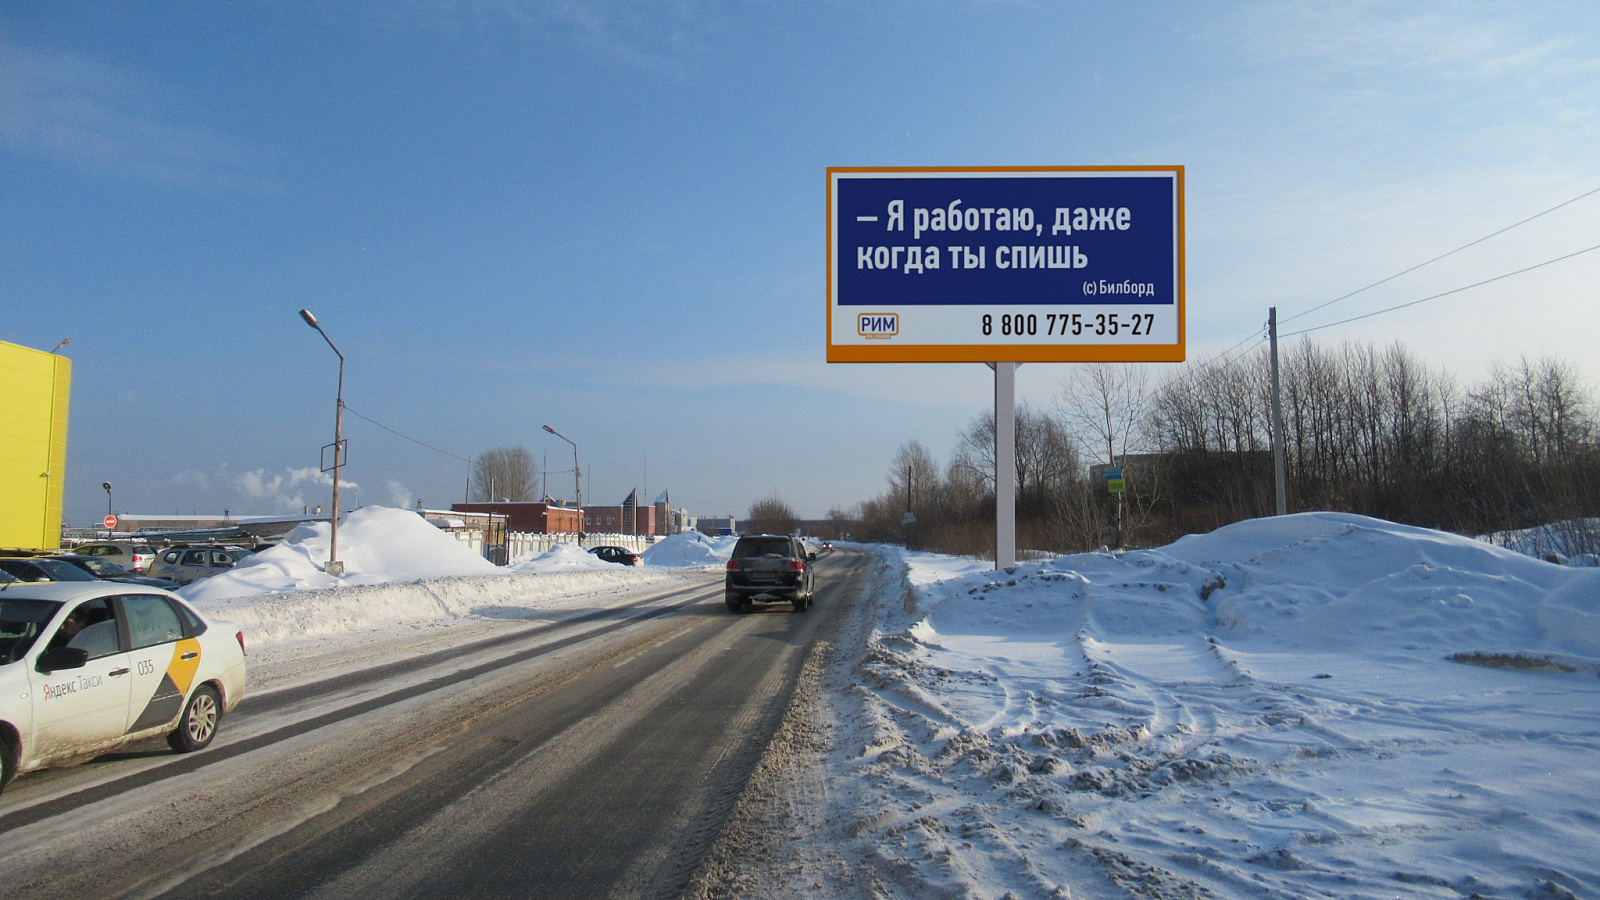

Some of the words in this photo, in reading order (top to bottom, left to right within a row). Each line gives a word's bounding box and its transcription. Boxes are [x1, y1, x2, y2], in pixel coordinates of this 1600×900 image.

[886, 200, 903, 231] Я
[914, 199, 1042, 239] работаю,
[1052, 207, 1131, 235] даже
[858, 246, 940, 274] когда
[948, 246, 986, 269] ты
[996, 246, 1088, 269] спишь
[1100, 280, 1155, 298] Билборд
[861, 317, 895, 332] РИМ
[982, 314, 993, 335] 8
[1002, 314, 1037, 335] 800
[1047, 314, 1155, 335] 775-35-27
[137, 659, 154, 676] 035
[43, 681, 77, 700] Яндекс
[78, 675, 103, 691] Такси
